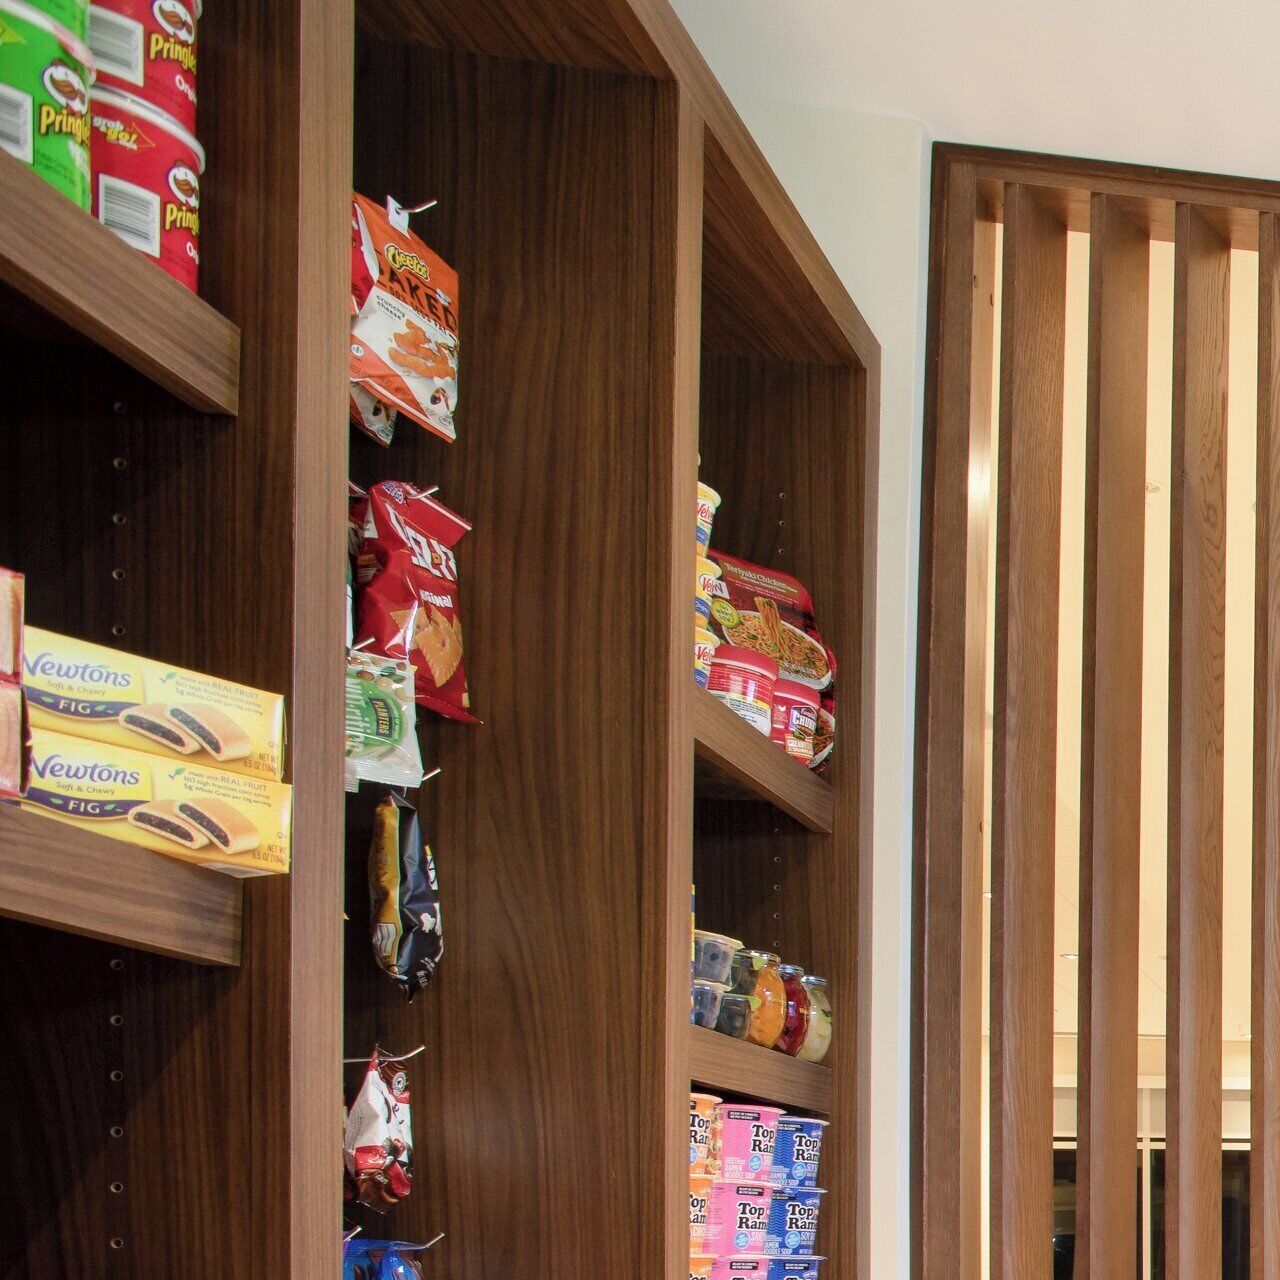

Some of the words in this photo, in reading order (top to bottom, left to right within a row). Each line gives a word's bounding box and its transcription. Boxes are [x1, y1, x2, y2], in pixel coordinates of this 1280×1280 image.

[385, 244, 429, 280] Cheetos
[23, 653, 131, 688] Newtons
[77, 684, 106, 697] Chewy
[211, 681, 233, 694] REAL
[235, 687, 260, 701] FRUIT
[58, 700, 91, 714] FIG
[373, 700, 391, 738] PLANTERS
[32, 754, 140, 786] Newtons
[56, 781, 75, 793] Soft
[86, 785, 115, 797] Chewy
[220, 775, 241, 788] REAL
[243, 780, 268, 792] FRUIT
[68, 800, 100, 814] FIG
[752, 1124, 775, 1140] Top
[795, 1134, 818, 1152] Top
[738, 1202, 765, 1220] Top
[788, 1203, 814, 1220] Top
